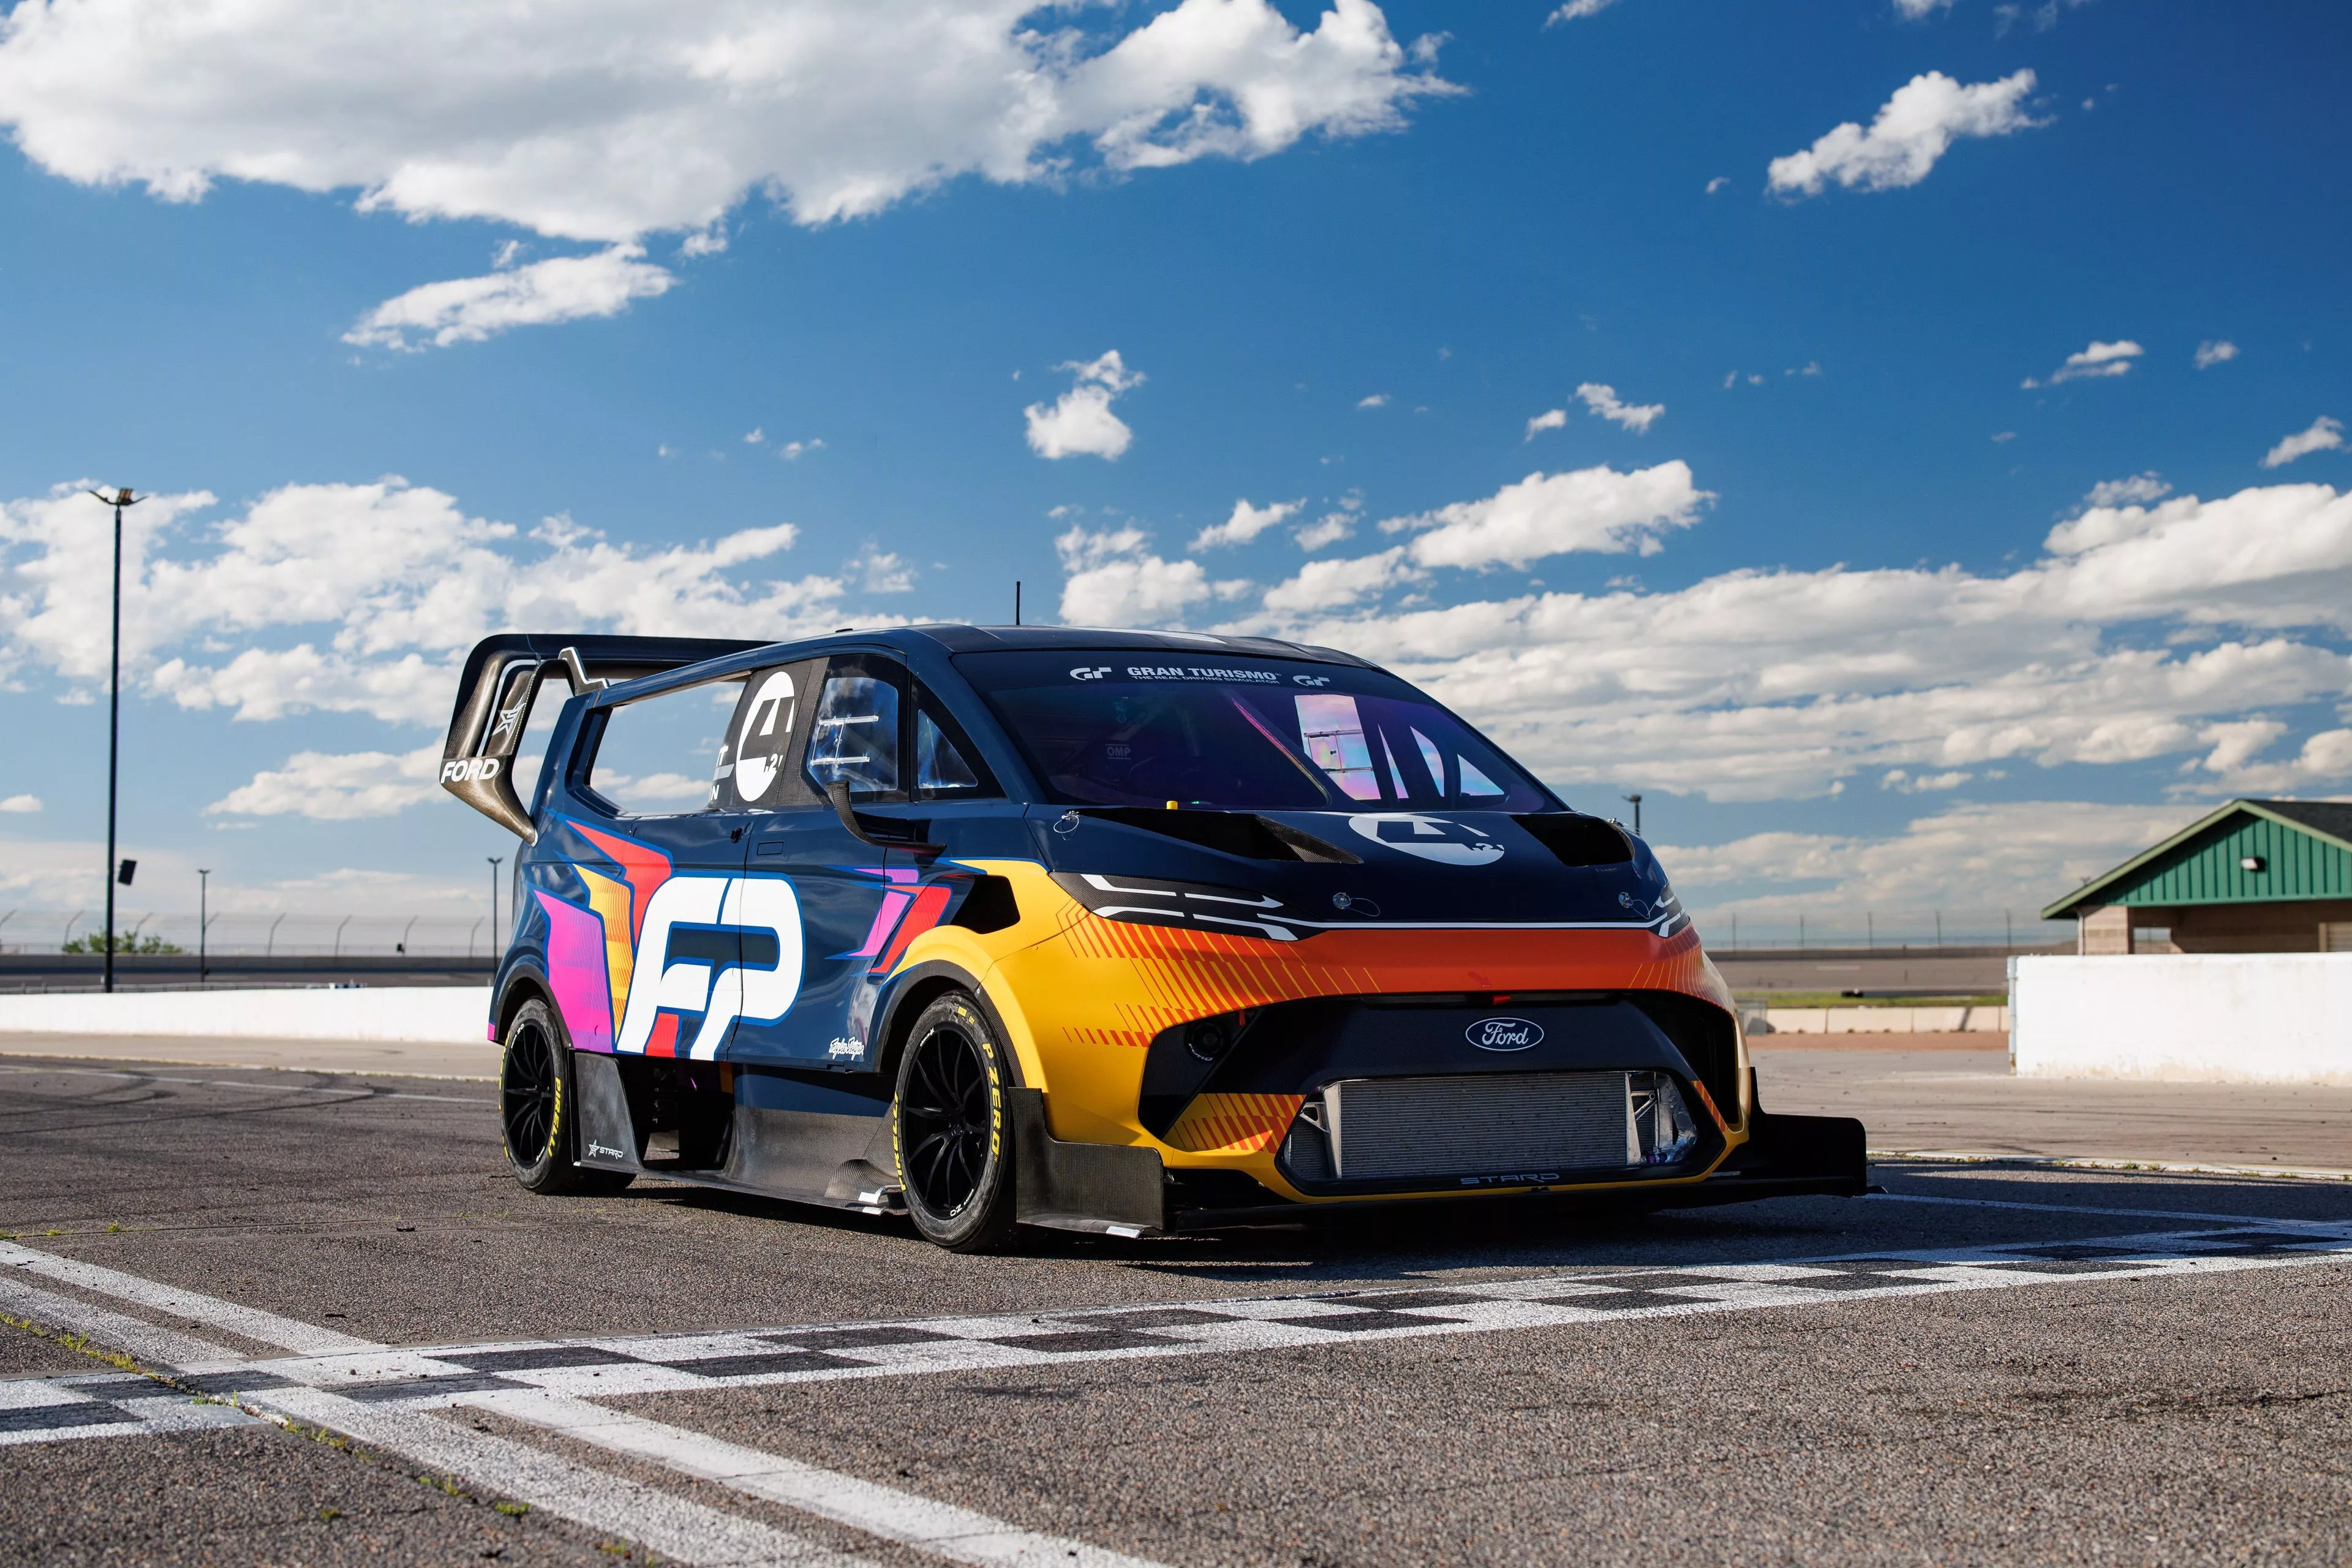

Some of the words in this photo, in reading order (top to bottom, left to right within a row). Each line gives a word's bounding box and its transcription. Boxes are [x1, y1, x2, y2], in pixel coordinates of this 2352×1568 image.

[1127, 667, 1185, 677] GRAN
[1187, 668, 1277, 681] TURISMO
[1107, 747, 1131, 757] OMP
[440, 758, 500, 784] FORD
[617, 876, 804, 1061] FP
[1482, 1022, 1529, 1045] Ford
[1188, 1043, 1213, 1061] FORD
[548, 1077, 561, 1157] PIRELLI
[989, 1066, 1001, 1156] ZERO
[892, 1091, 907, 1191] PIRELLI
[600, 1147, 624, 1160] STARD
[1460, 1173, 1559, 1185] STARD
